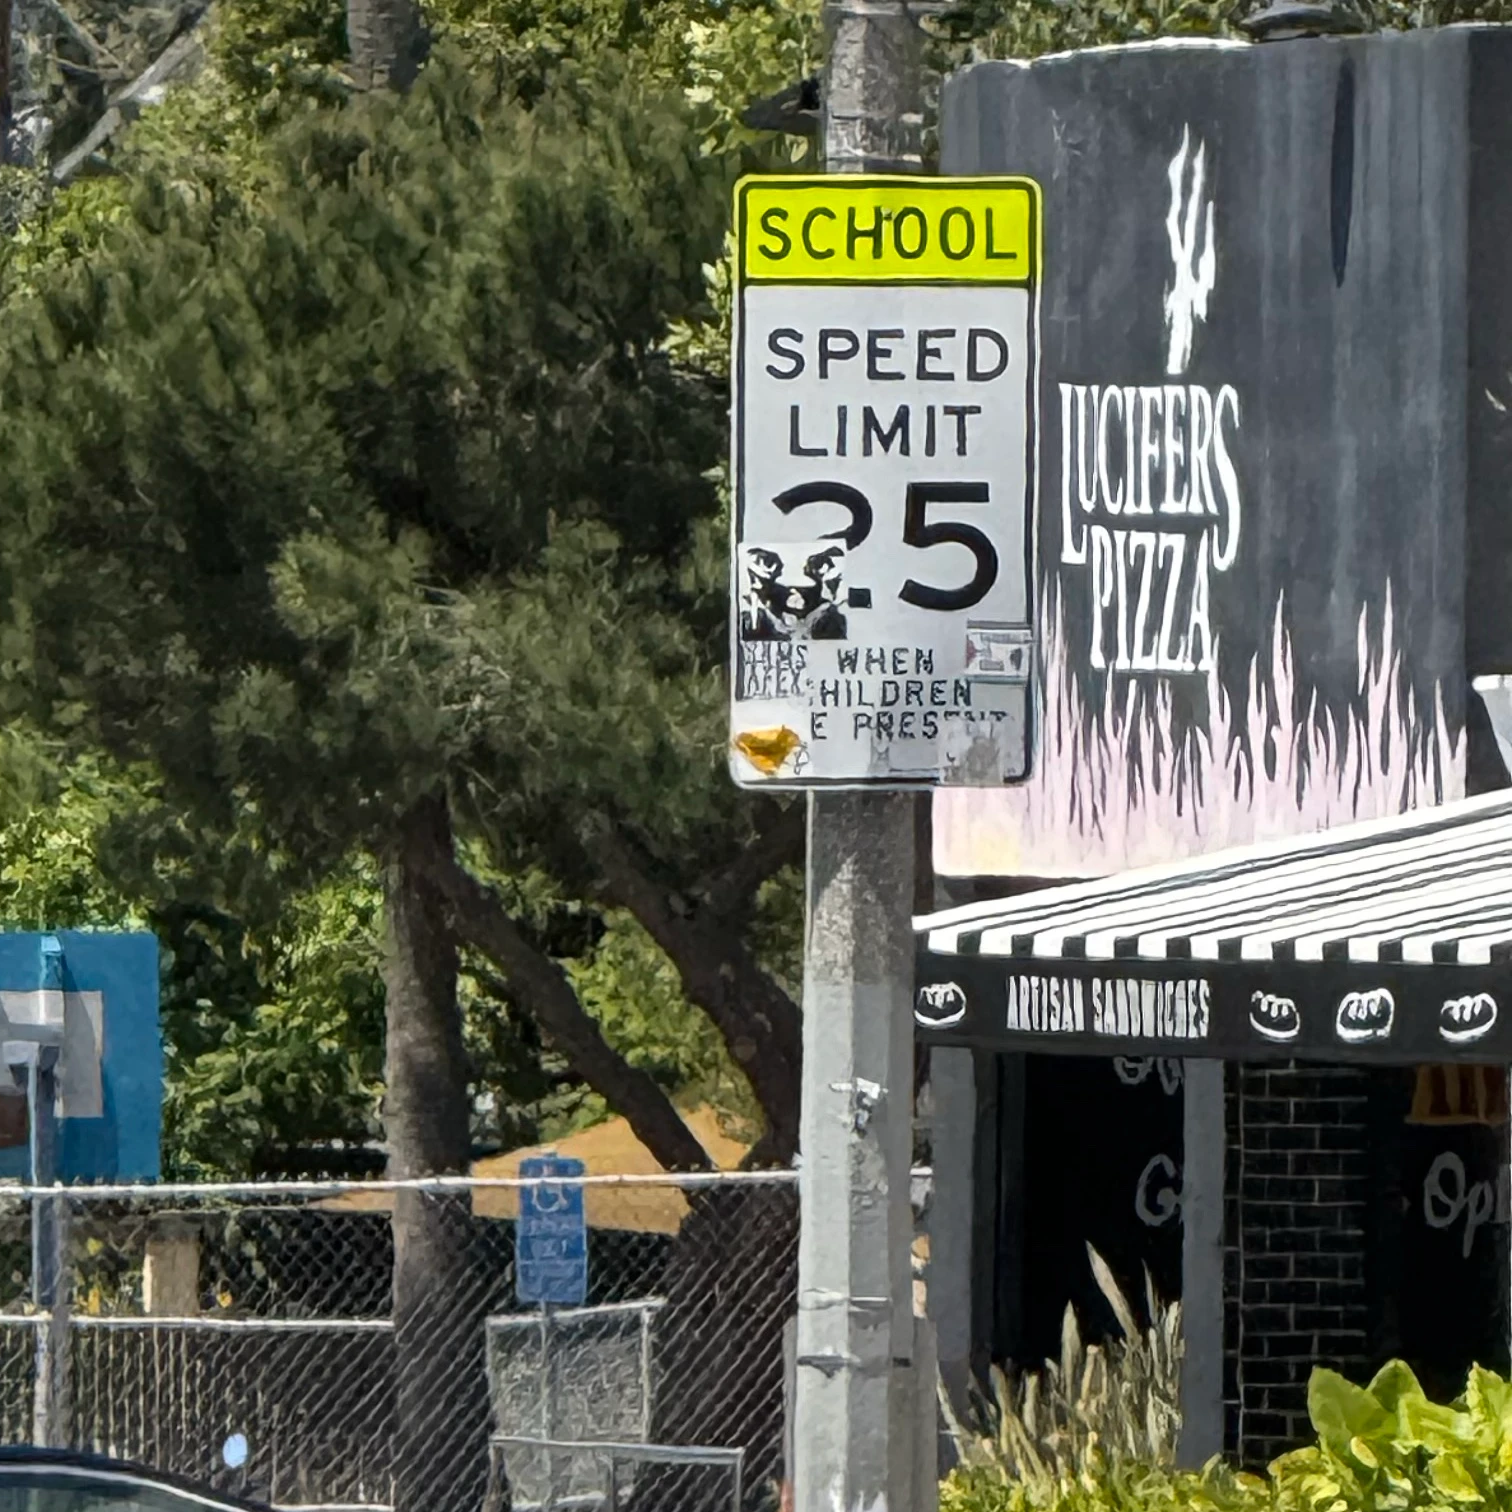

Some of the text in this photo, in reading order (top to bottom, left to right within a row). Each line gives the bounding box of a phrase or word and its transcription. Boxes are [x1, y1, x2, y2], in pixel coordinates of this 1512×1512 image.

[758, 206, 1017, 261] SCHOOL
[765, 327, 1009, 382] SPEED
[790, 404, 982, 458] LIMIT
[1058, 383, 1242, 572] LUCIFERS
[1089, 526, 1214, 673] PIZZA
[837, 647, 934, 675] WHEN
[807, 679, 971, 707] HILDREN
